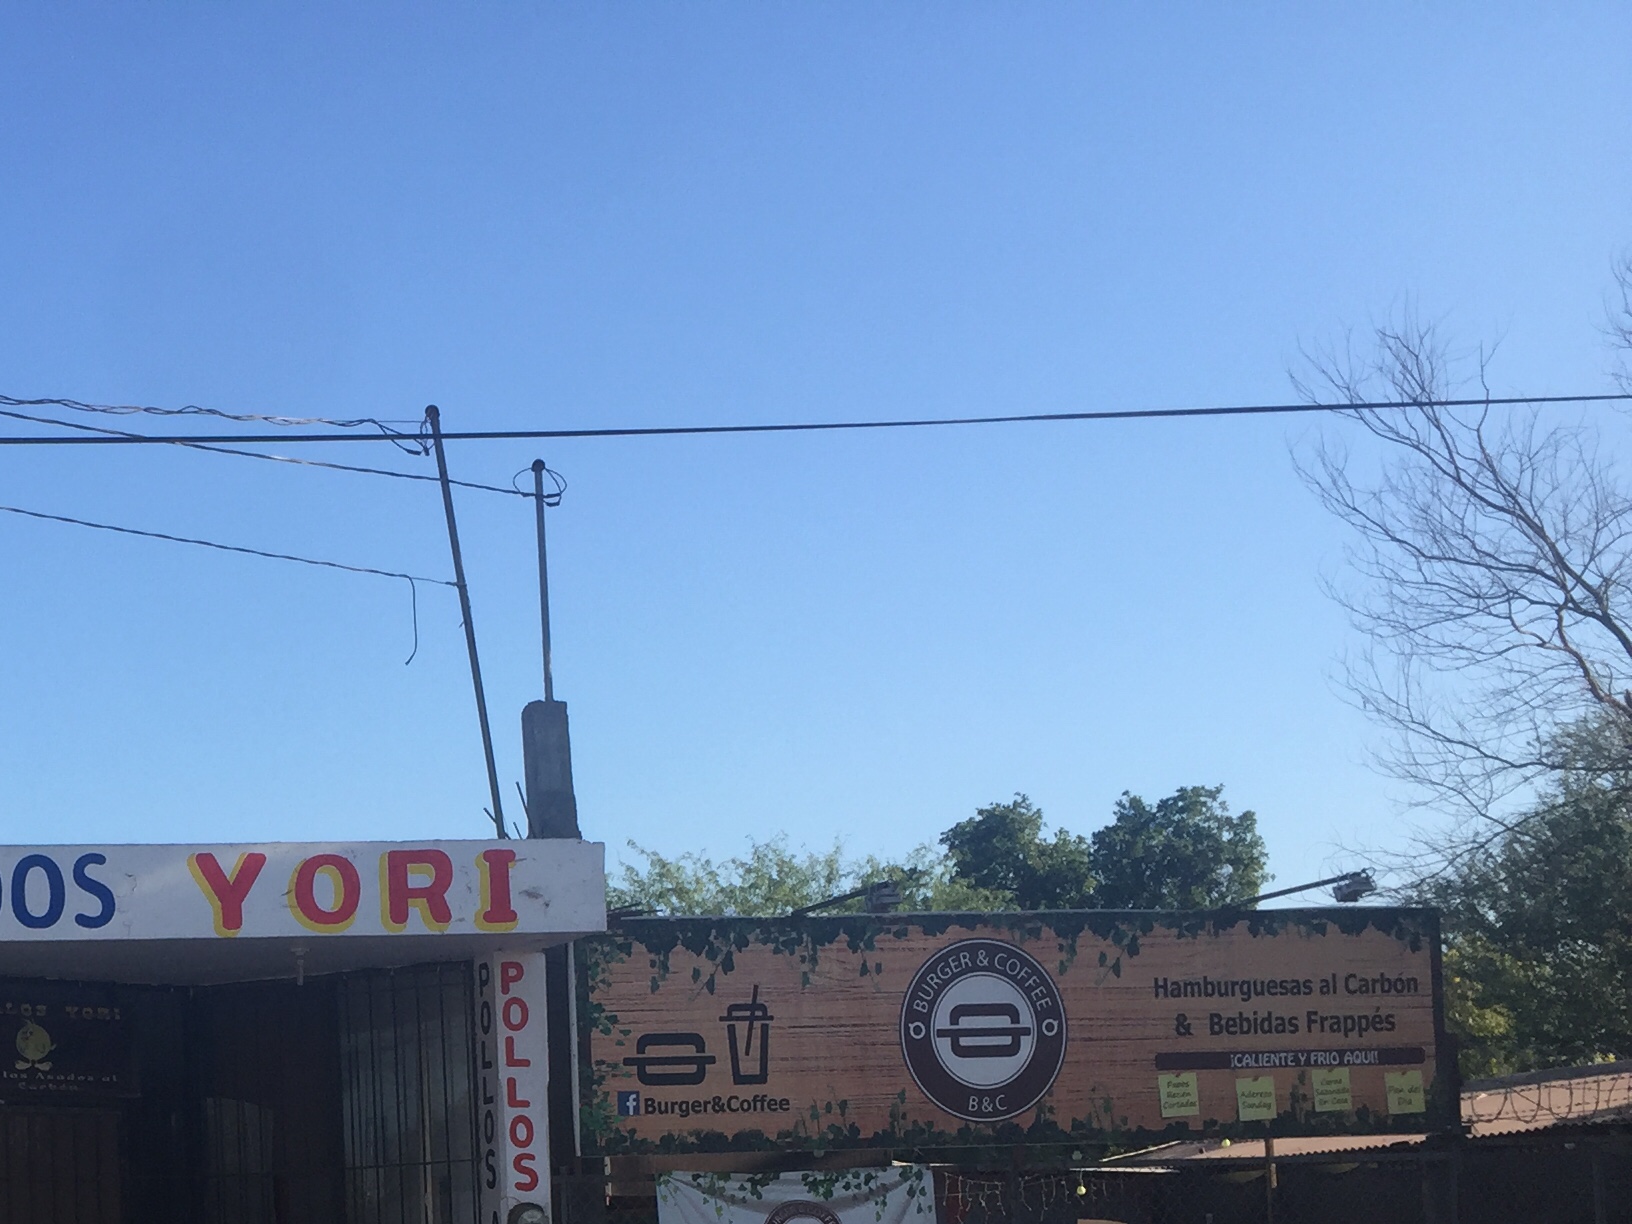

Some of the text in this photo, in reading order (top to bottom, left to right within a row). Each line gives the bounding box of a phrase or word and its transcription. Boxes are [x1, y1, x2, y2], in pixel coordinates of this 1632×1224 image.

[187, 848, 520, 938] YORI
[913, 949, 1052, 1013] BURGER & COFFEE
[1154, 972, 1419, 1002] Hamburguesas al Carbón
[1175, 1007, 1396, 1038] & Bebidas Frappés
[1230, 1052, 1296, 1068] ¡CALIENTE
[1298, 1052, 1307, 1066] Y
[1310, 1051, 1340, 1065] FRIO
[478, 962, 497, 1190] POLLOS
[500, 961, 540, 1192] POLLOS
[644, 1094, 791, 1118] Burger&Coffee
[968, 1094, 1007, 1112] B&C
